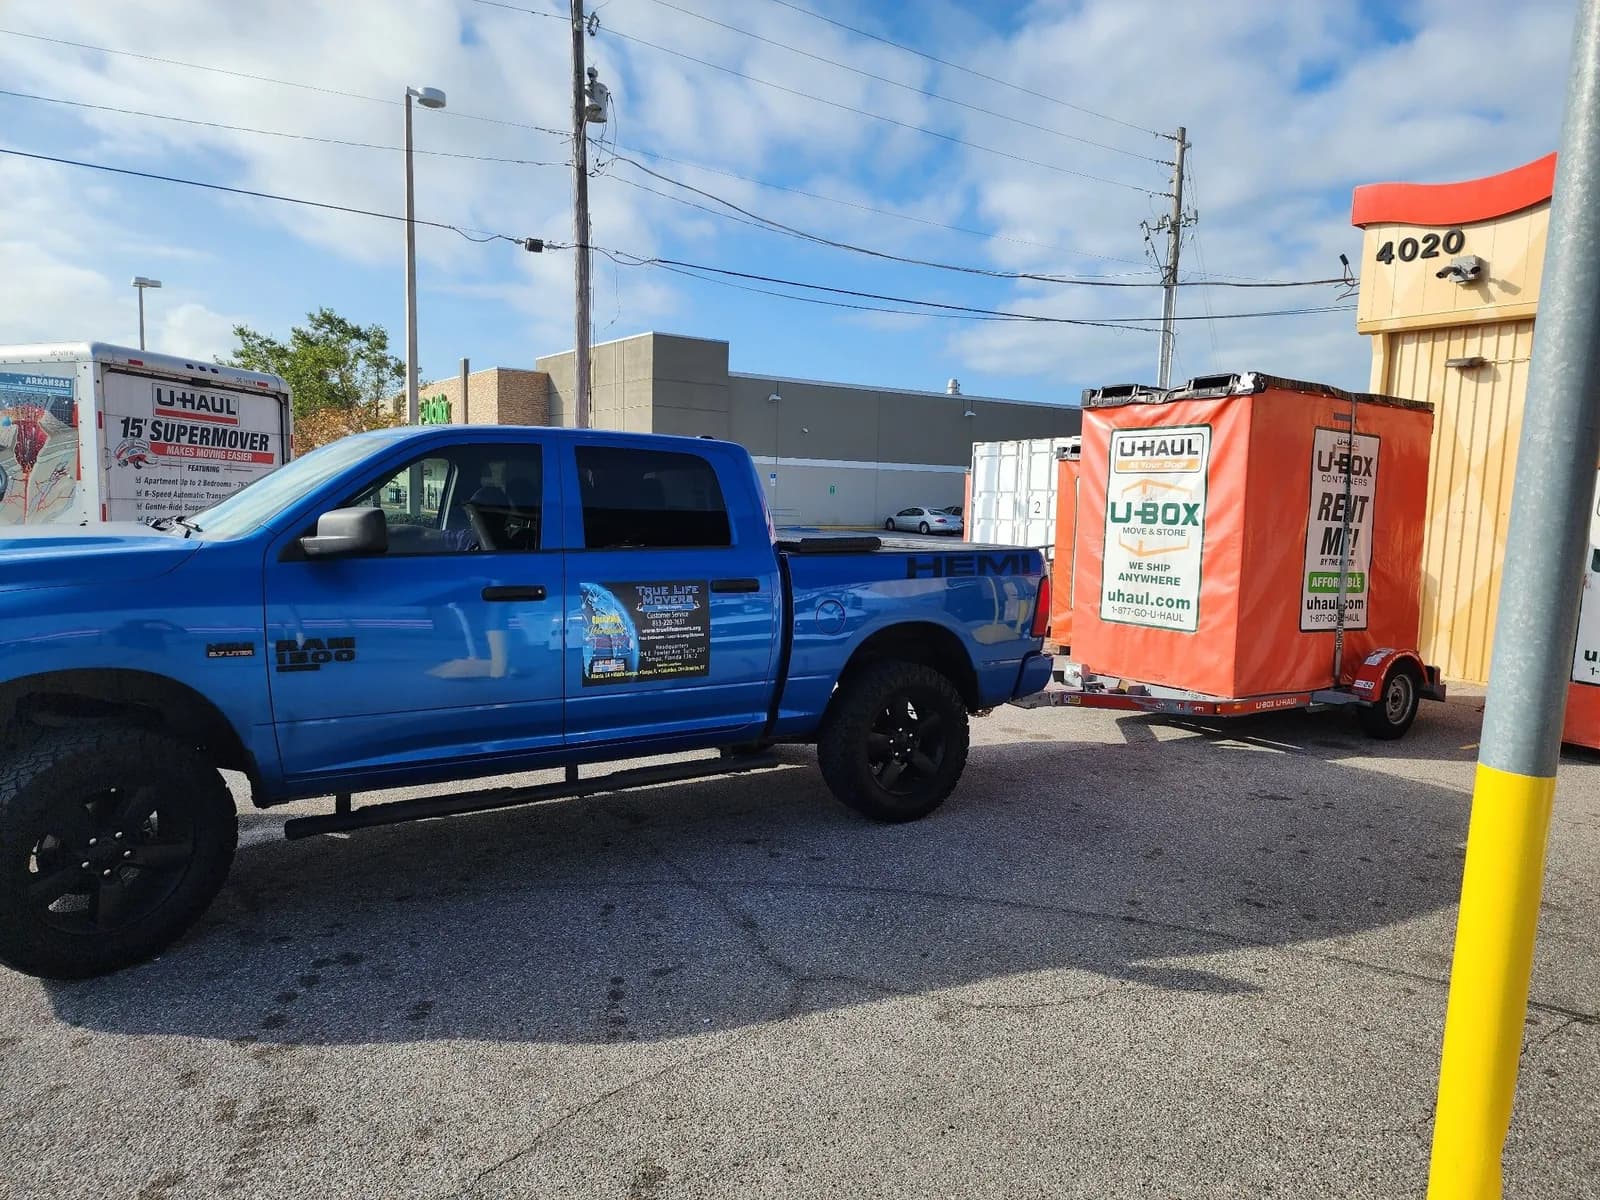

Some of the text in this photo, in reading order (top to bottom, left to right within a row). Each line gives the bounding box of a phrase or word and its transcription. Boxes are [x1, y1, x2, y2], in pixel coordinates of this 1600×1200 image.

[1376, 228, 1466, 265] 4020
[25, 376, 70, 388] ARKANSAS
[156, 387, 237, 416] U-HAUL
[120, 416, 270, 452] 15' SUPERMOVER
[166, 445, 253, 462] MAKES MOVING EASIER
[1120, 438, 1199, 457] U-HAUL
[187, 464, 220, 473] FEATURING
[1317, 450, 1374, 477] U-BOX
[143, 476, 178, 486] Apartment
[197, 479, 202, 487] 2
[203, 479, 232, 488] Bedrooms
[1321, 474, 1368, 487] CONTANERS
[174, 491, 205, 500] Automatic
[145, 502, 182, 512] Gentle-Ride
[1033, 501, 1041, 514] 2
[1110, 501, 1201, 526] U-BOX
[1317, 491, 1370, 523] RENT
[1122, 527, 1186, 537] MOVE & STORE
[906, 554, 1032, 579] HEMI
[1128, 561, 1171, 573] WE SHIP
[1328, 558, 1338, 566] THE
[1118, 572, 1181, 586] ANYWHERE
[1311, 576, 1361, 588] AFFORBLE
[635, 584, 700, 596] TRUE LIFE
[642, 594, 694, 605] MOVERS
[1107, 589, 1191, 610] uhaul.com
[1306, 596, 1364, 610] uhaulcom
[1111, 605, 1184, 623] 1-877-GO-U-HAUL
[1256, 700, 1275, 709] U-BOX
